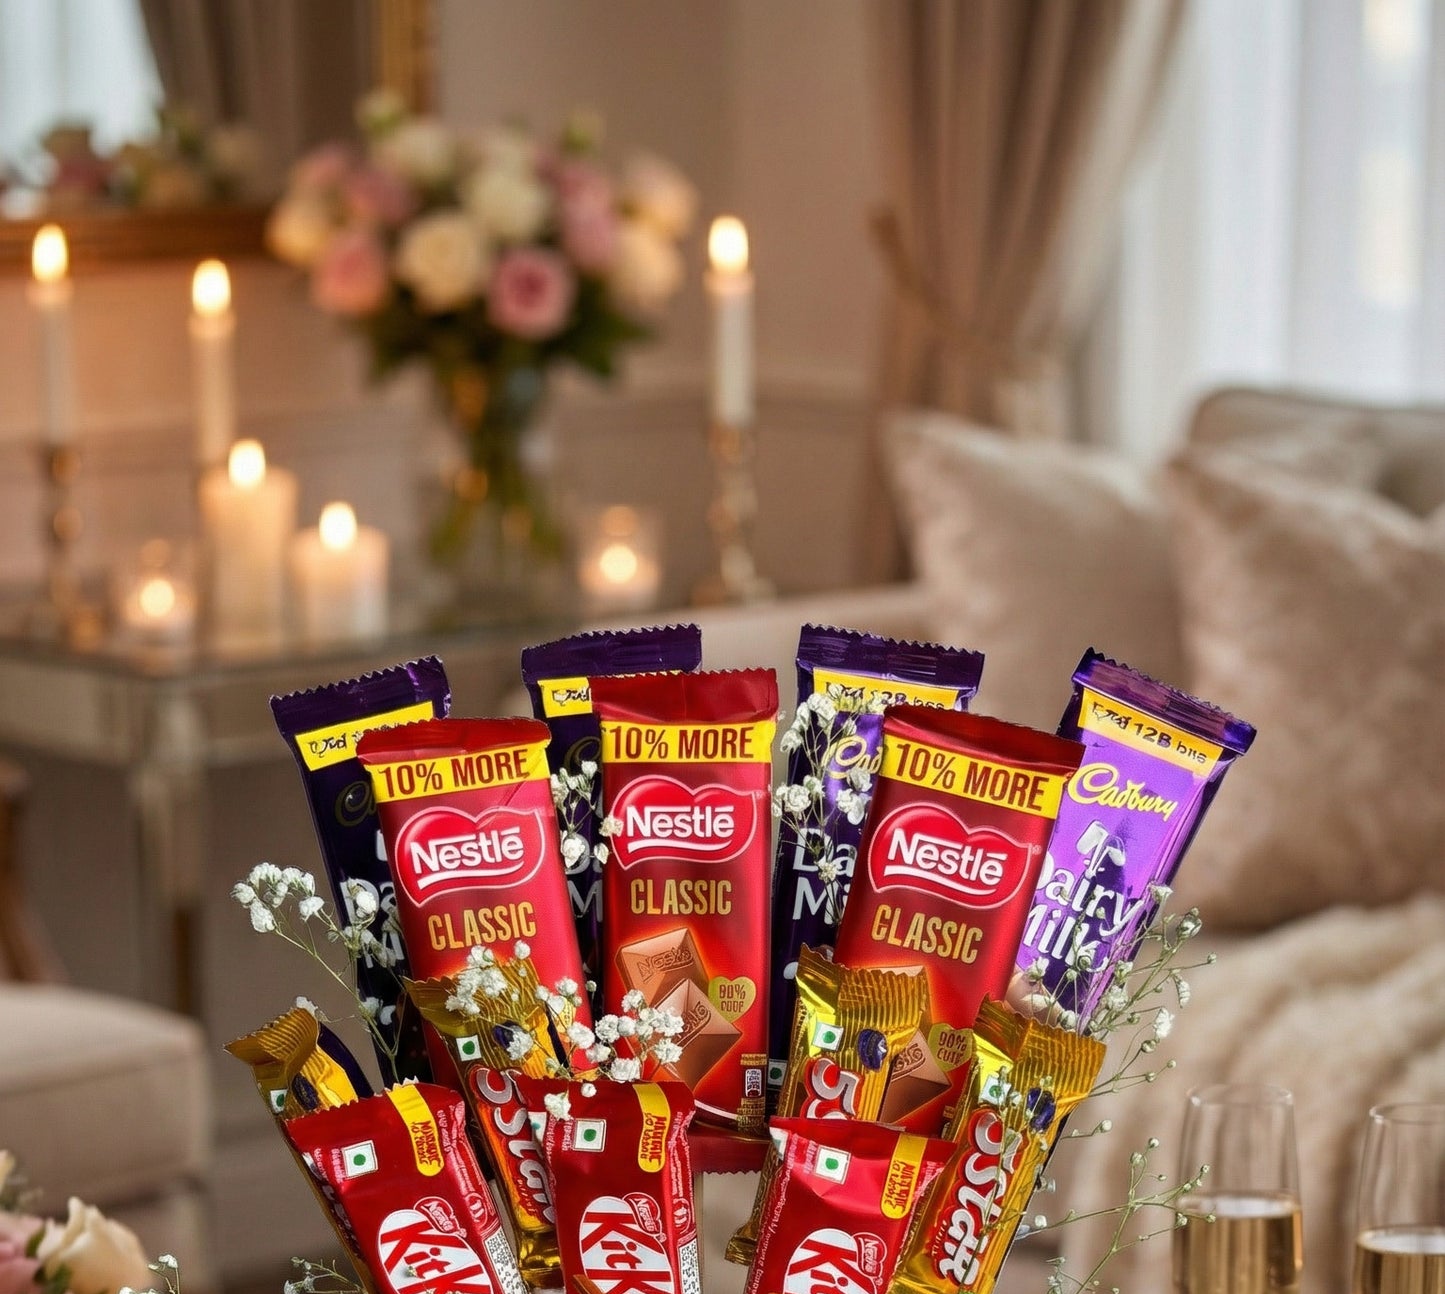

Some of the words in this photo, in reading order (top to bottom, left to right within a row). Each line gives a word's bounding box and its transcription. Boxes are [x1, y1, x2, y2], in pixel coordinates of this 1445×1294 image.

[610, 726, 669, 760] 10%
[678, 726, 755, 760] MORE
[379, 762, 443, 798] 10%
[451, 749, 530, 788] MORE
[896, 743, 957, 790] 10%
[963, 761, 1050, 812] MORE
[1068, 762, 1178, 822] Cadbury
[626, 805, 735, 838] Nestlé
[410, 826, 524, 875] Nestlé
[887, 828, 1008, 886] Nestlé
[631, 878, 733, 916] CLASSIC
[427, 901, 537, 952] CLASSIC
[871, 904, 983, 964] CLASSIC
